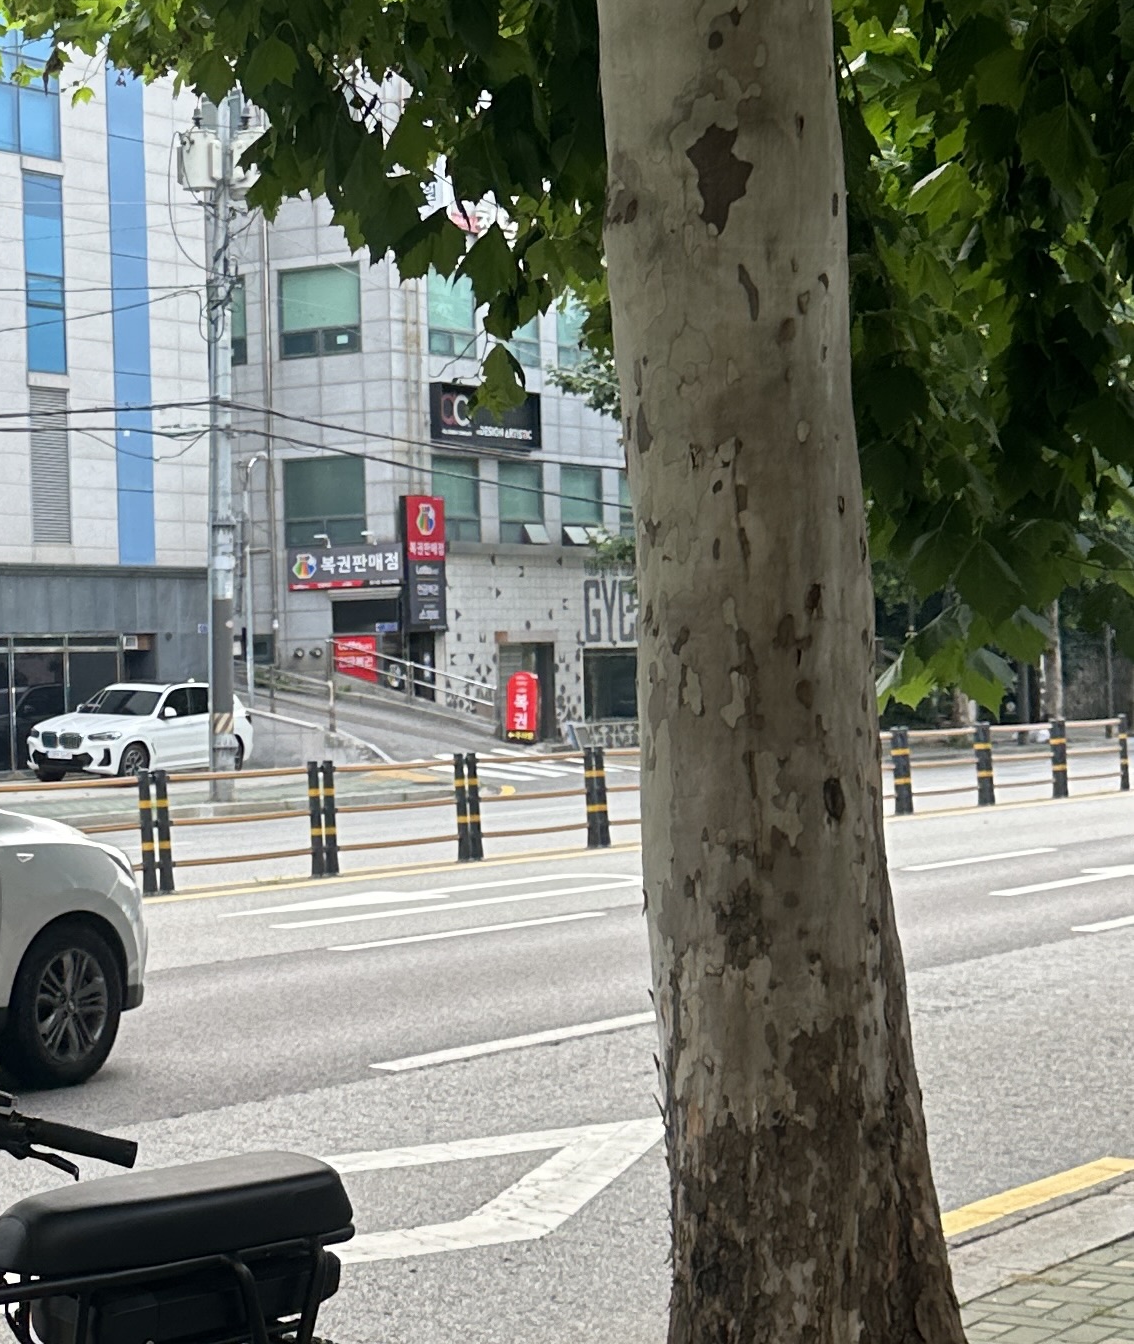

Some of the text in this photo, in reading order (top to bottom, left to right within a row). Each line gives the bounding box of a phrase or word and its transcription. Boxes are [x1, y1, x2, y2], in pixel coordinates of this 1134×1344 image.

[410, 541, 445, 556] 복권판매점
[320, 552, 400, 574] 복권판매점
[513, 693, 529, 730] 복권
